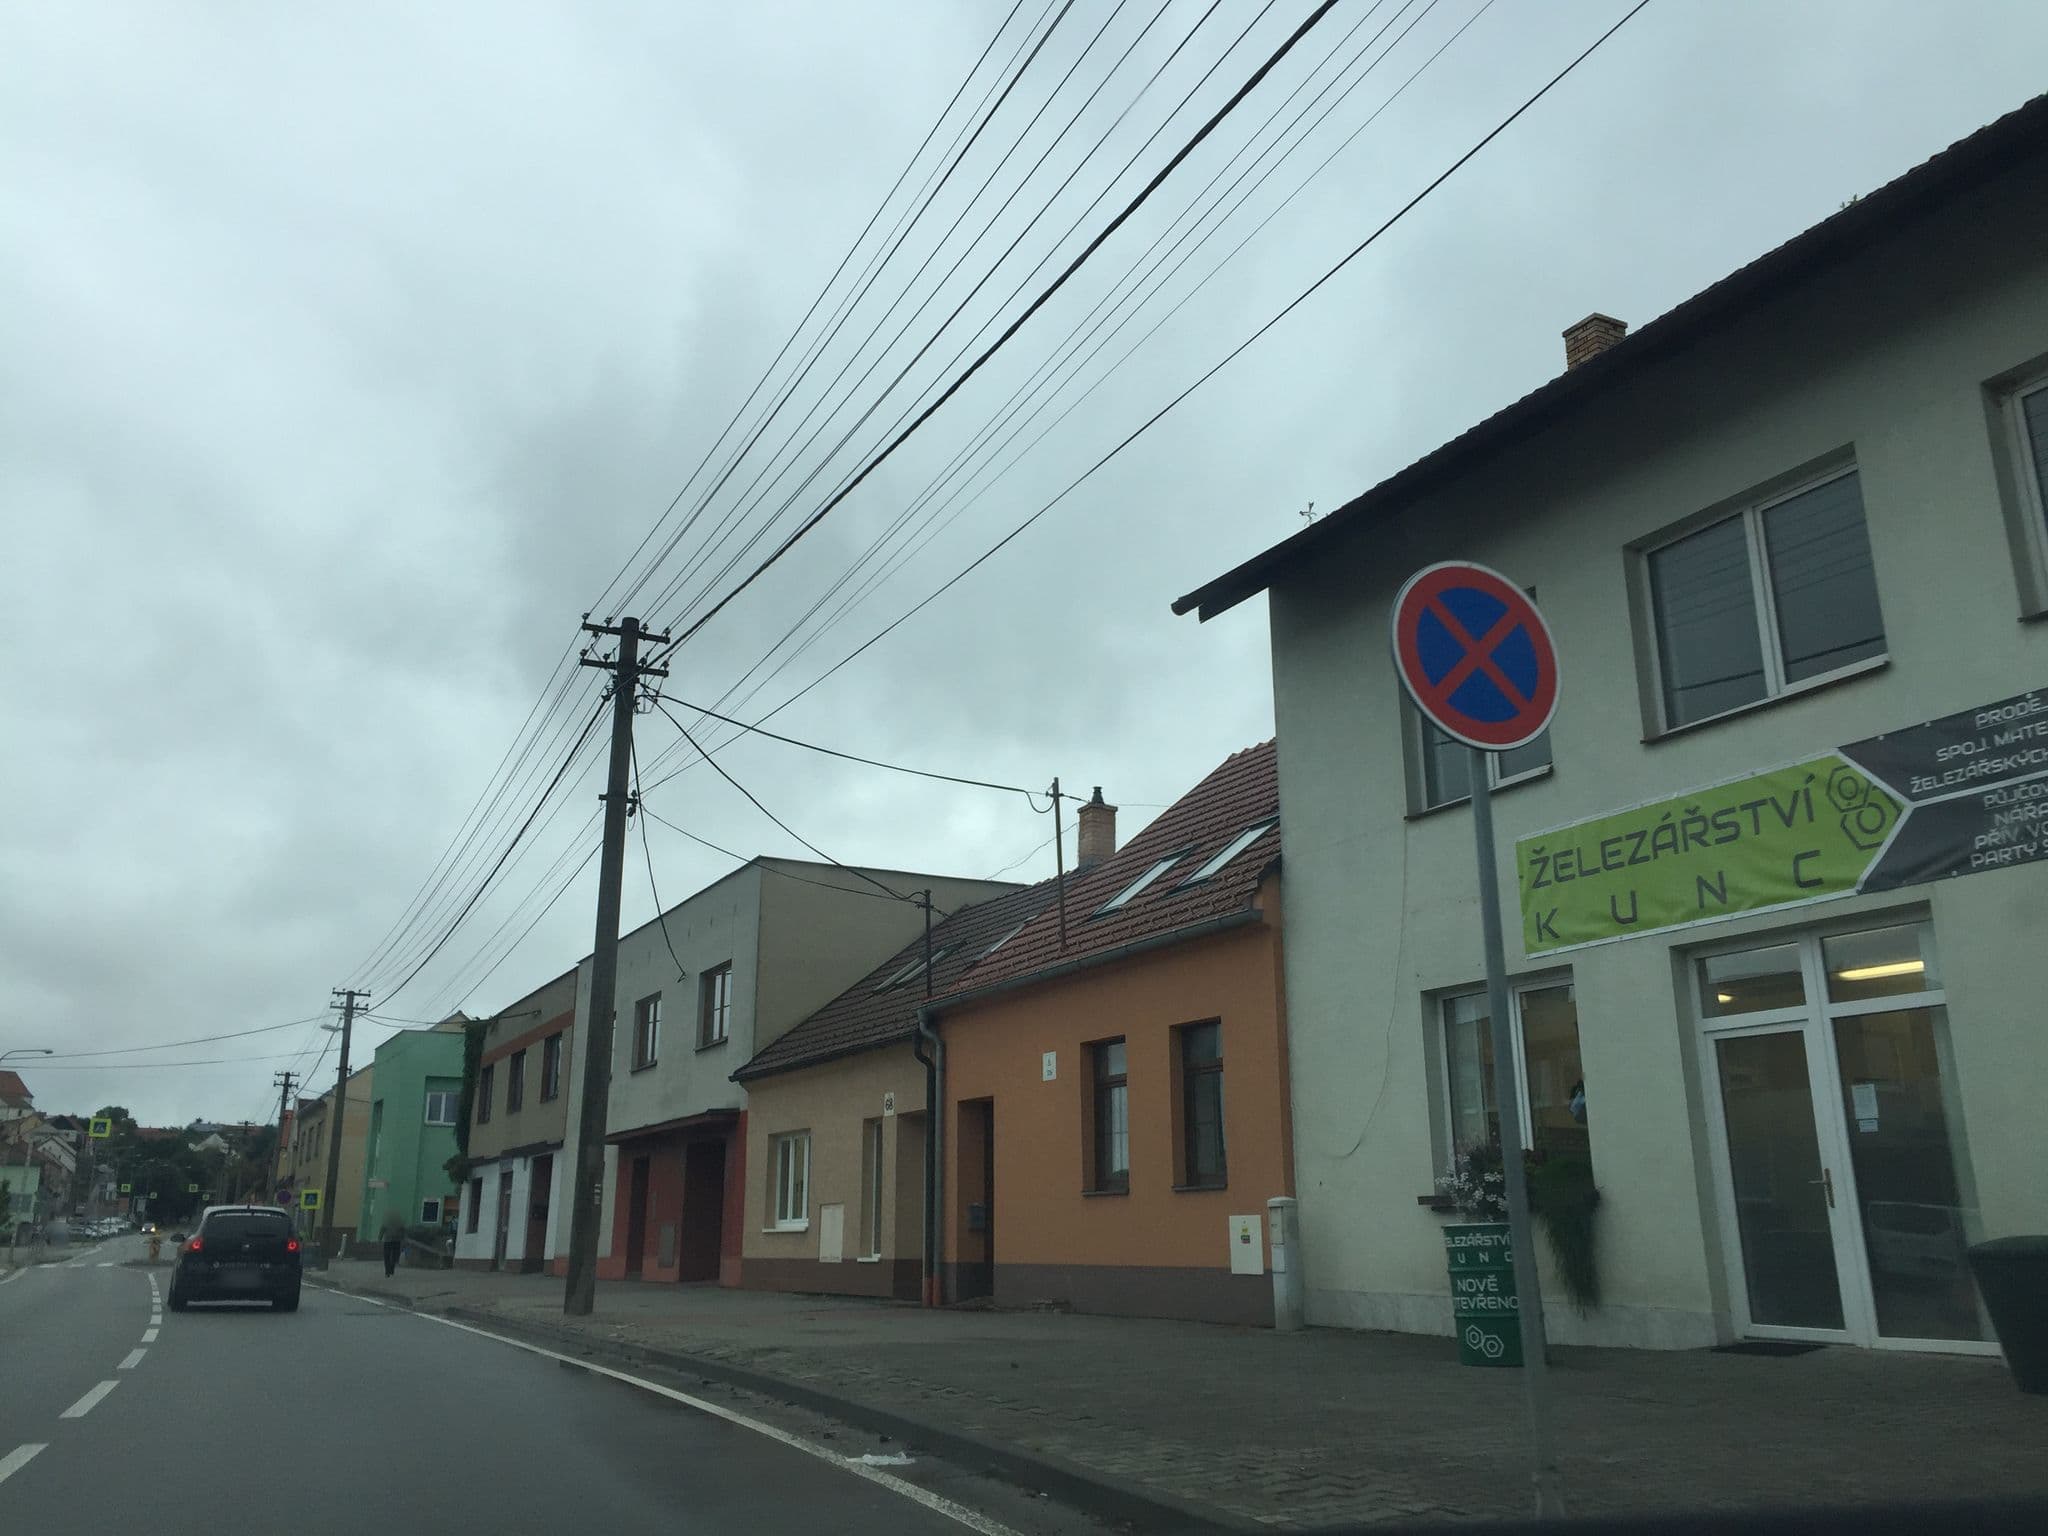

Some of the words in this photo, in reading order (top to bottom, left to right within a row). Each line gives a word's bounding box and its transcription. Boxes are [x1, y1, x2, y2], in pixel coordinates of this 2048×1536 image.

[1975, 697, 2048, 727] PRODE
[1529, 773, 1815, 889] ŽELEZÁŘSTVÍ
[1970, 841, 2037, 867] PARTY
[1446, 1232, 1511, 1247] ELEZÁŘSTVÍ
[1456, 1274, 1499, 1292] NOVĚ
[1454, 1293, 1520, 1309] TEVŘENO
